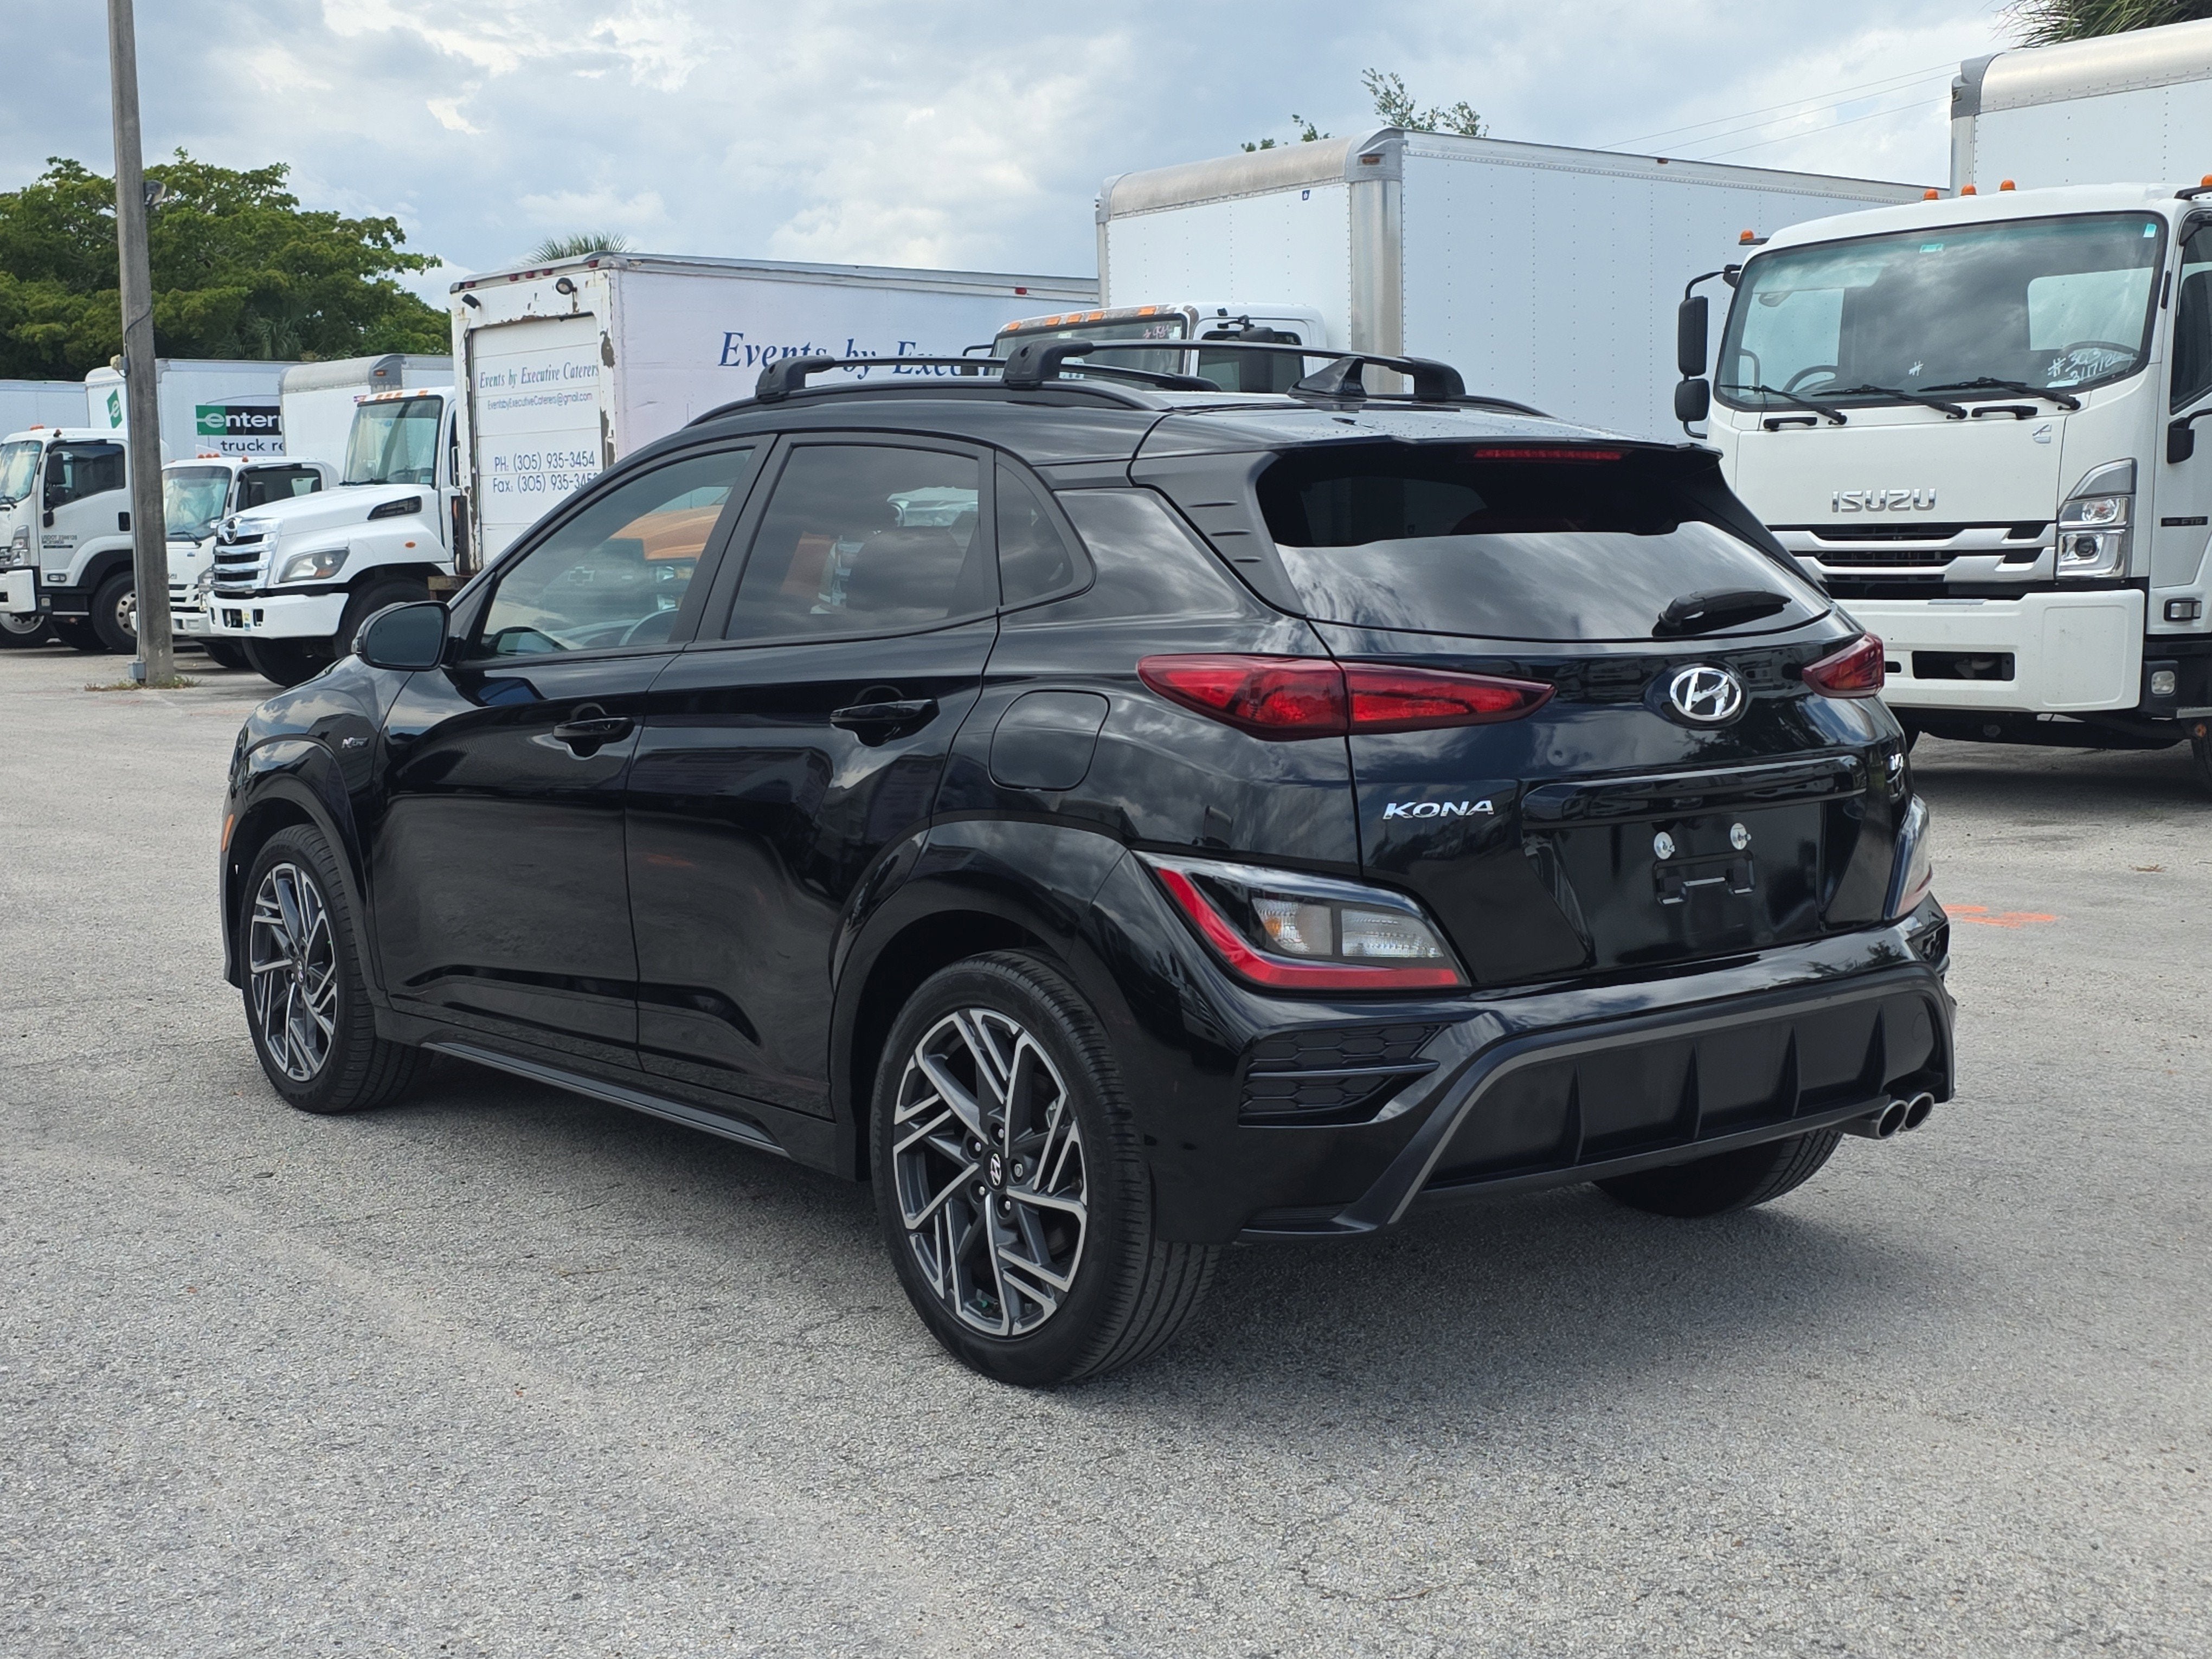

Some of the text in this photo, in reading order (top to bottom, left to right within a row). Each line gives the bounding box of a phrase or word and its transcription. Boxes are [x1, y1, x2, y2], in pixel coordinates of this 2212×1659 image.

[479, 362, 599, 389] Events by Executive Caterers
[220, 438, 266, 451] truck
[494, 451, 595, 472] PH: (305) 935-3454
[493, 477, 513, 493] Fax:
[518, 472, 546, 493] (305)
[1832, 488, 1936, 512] ISUZU
[1382, 800, 1494, 820] KONA
